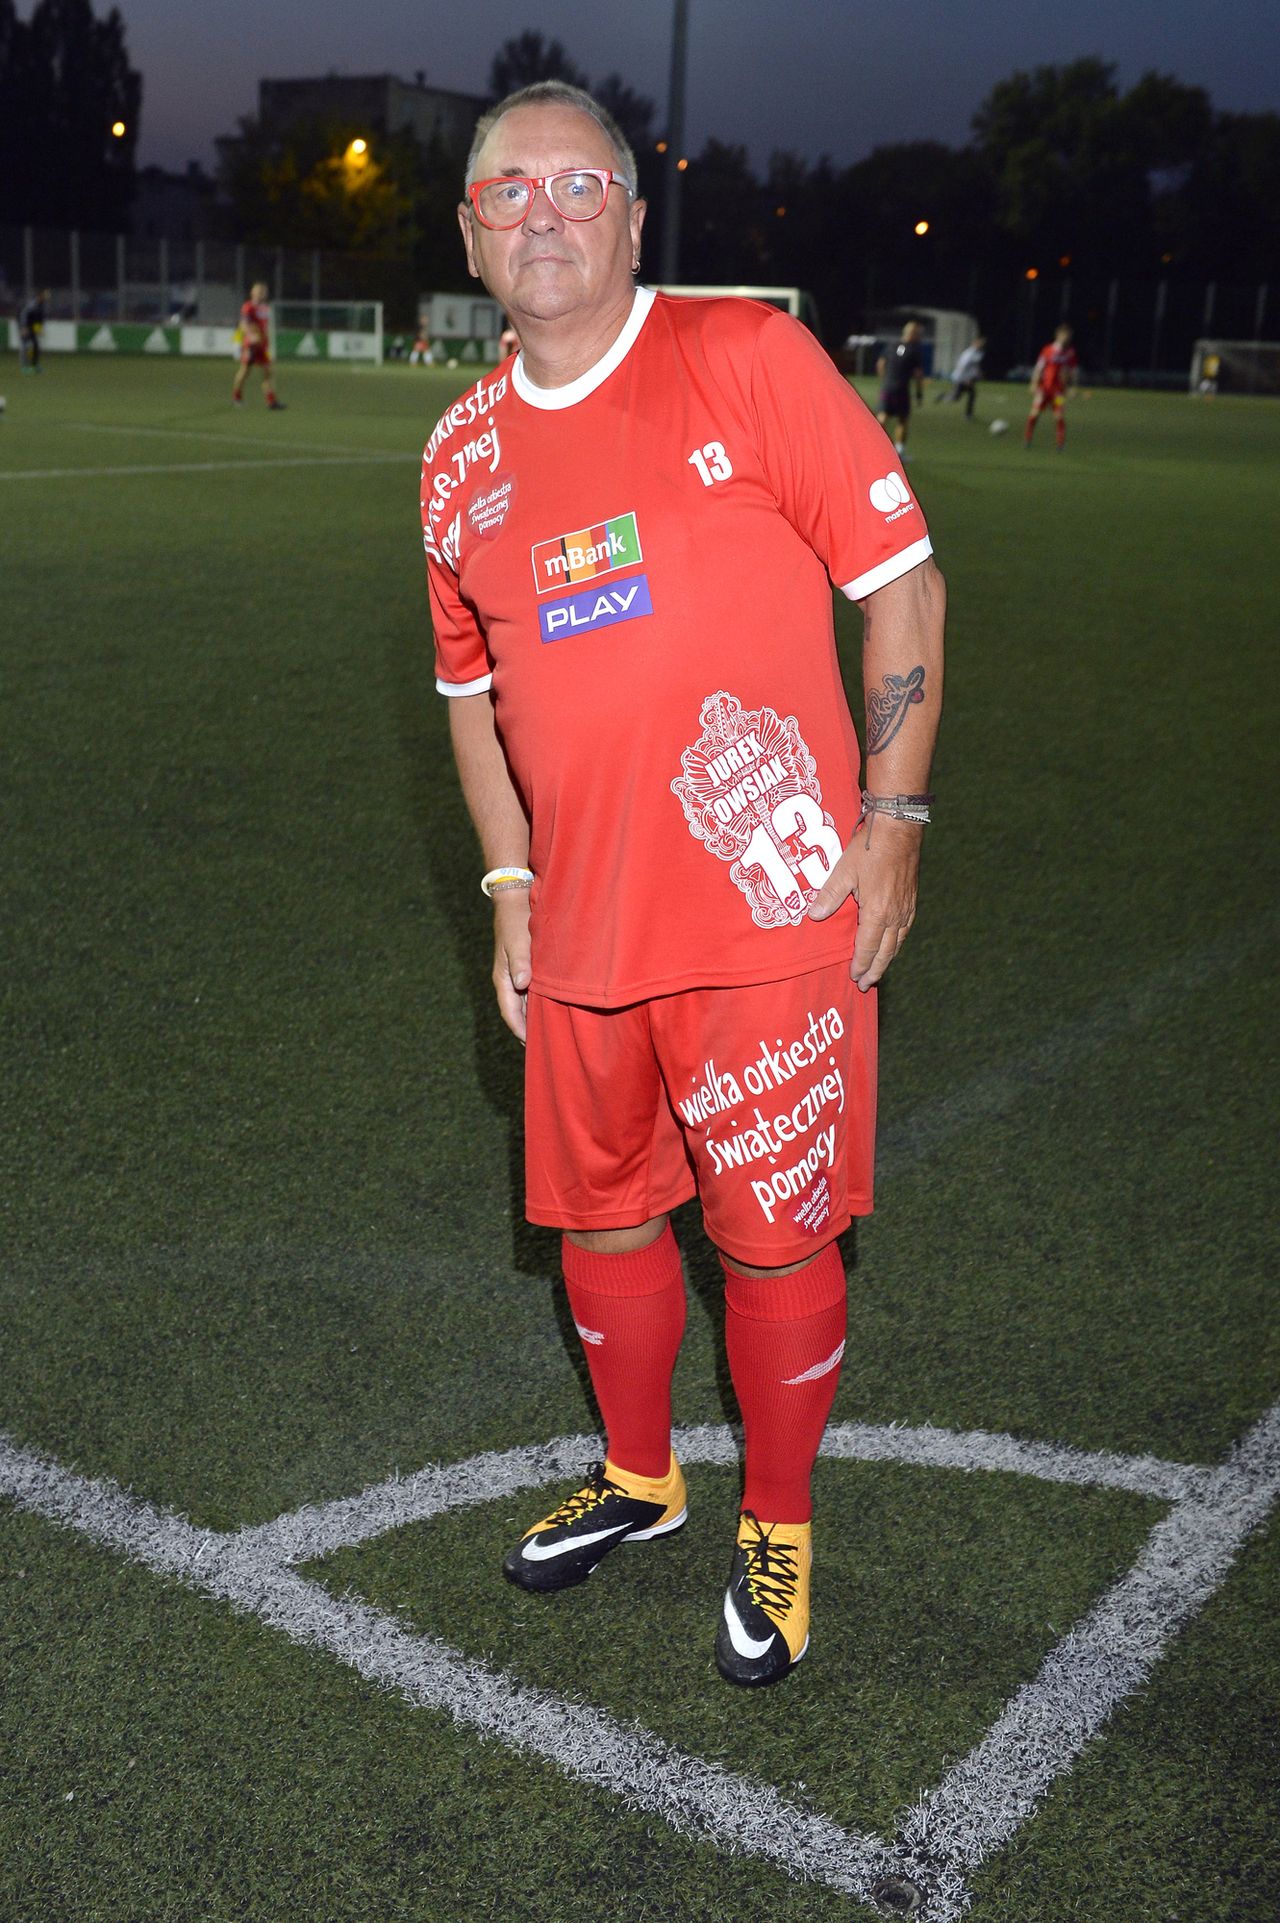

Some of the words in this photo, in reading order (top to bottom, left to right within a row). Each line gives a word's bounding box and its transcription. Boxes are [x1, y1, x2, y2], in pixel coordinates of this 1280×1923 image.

[687, 441, 734, 487] 13
[479, 514, 504, 535] pomocy
[544, 532, 627, 577] mBank
[546, 586, 639, 633] PLAY
[704, 731, 767, 788] JUREK
[712, 753, 790, 824] OWSIAK
[739, 793, 844, 919] 13
[678, 1059, 745, 1127] wielka
[743, 1007, 845, 1096] orkiestra
[705, 1057, 845, 1176] świątecznej
[750, 1124, 836, 1223] pomocy
